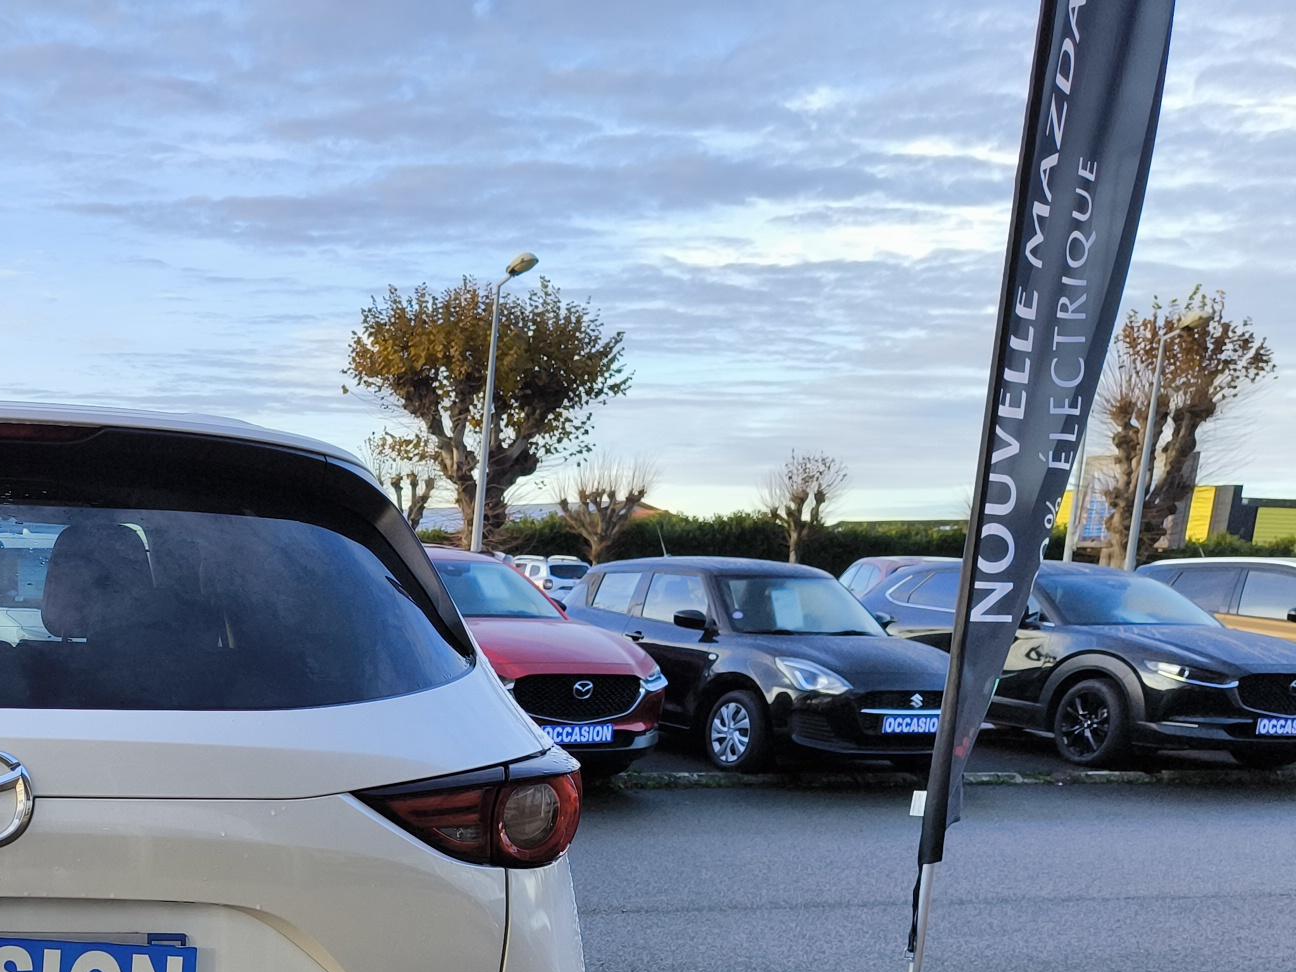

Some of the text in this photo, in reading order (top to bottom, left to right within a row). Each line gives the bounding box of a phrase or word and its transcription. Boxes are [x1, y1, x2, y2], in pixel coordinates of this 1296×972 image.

[970, 0, 1086, 622] NOUVELLE MAZDA
[1039, 157, 1097, 470] ÉLECTRIQUE
[885, 717, 939, 733] OCCASIO
[1259, 719, 1296, 734] OCCAS
